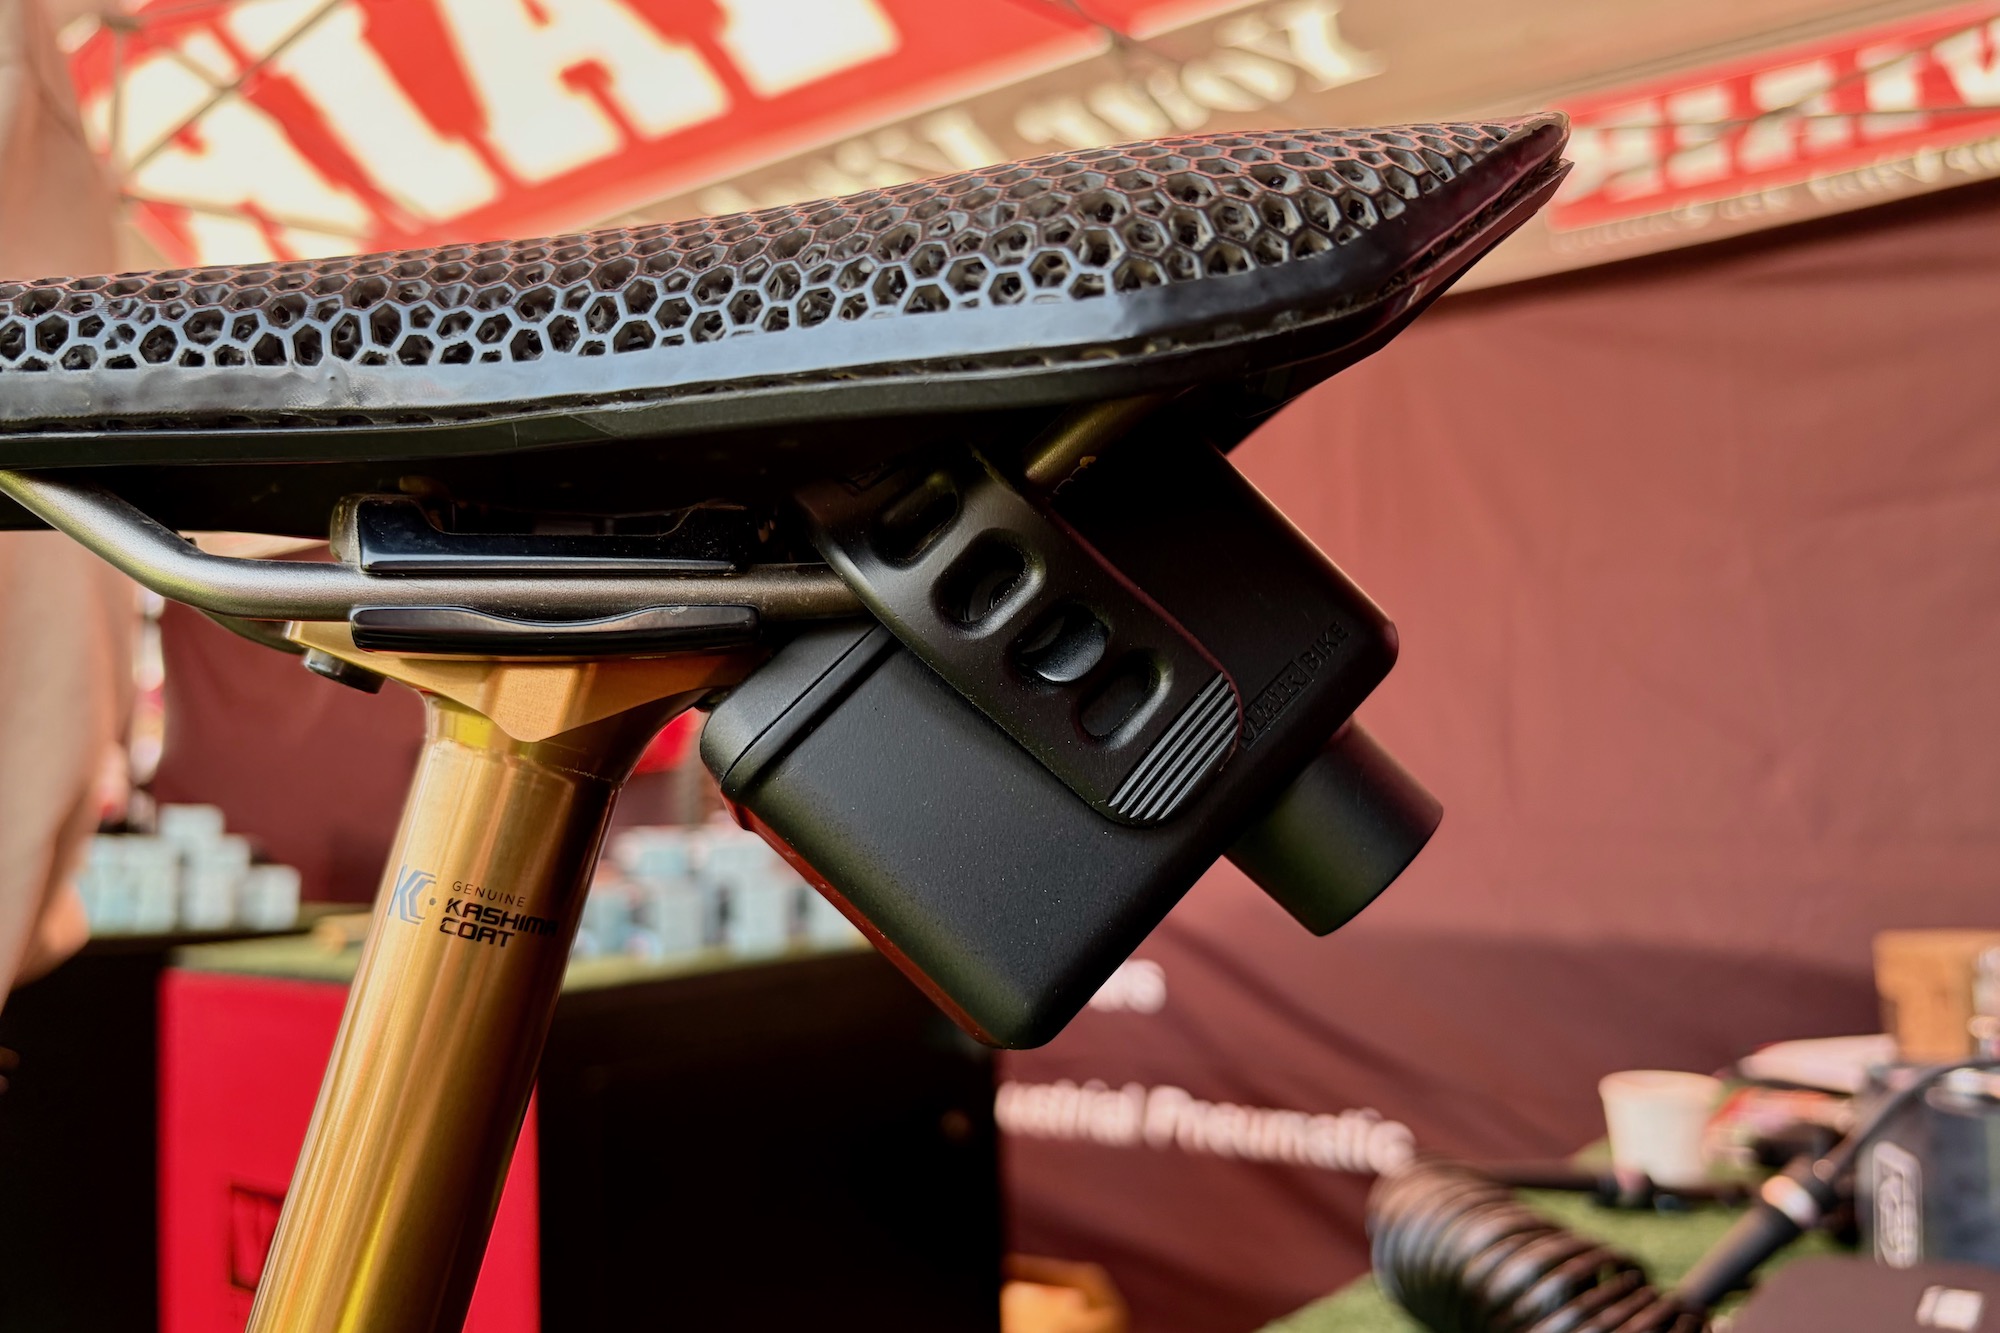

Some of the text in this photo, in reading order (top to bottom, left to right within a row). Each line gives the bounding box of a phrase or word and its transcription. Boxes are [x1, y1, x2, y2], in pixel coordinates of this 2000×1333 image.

[1301, 620, 1349, 672] BIKE
[452, 880, 527, 908] GENUINE
[439, 916, 516, 948] COAT
[445, 897, 559, 937] KASHIMA
